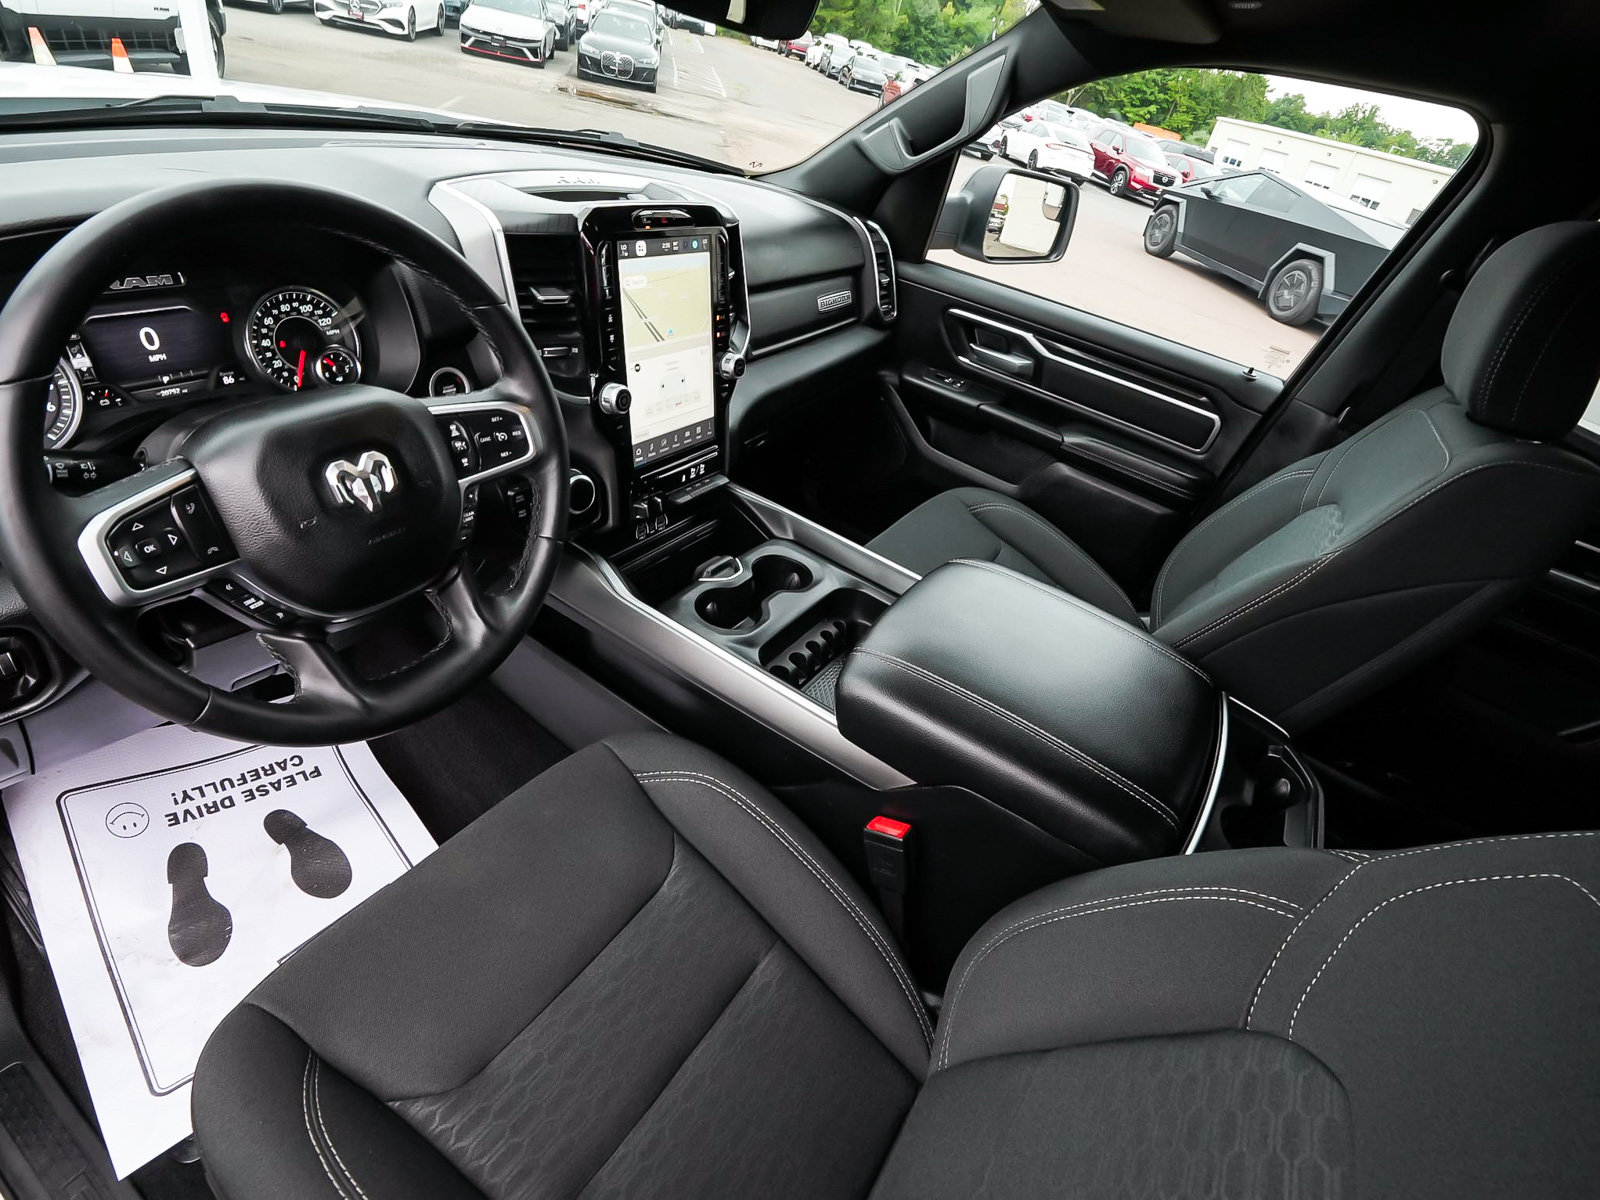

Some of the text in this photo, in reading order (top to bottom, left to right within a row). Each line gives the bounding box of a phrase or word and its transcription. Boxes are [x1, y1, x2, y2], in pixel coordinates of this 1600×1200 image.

[271, 308, 279, 316] 70
[280, 303, 291, 312] 80
[299, 303, 313, 313] 100
[263, 316, 274, 326] 60
[317, 317, 332, 326] 120
[138, 326, 161, 351] 0
[261, 339, 272, 347] 40
[148, 353, 167, 362] MPH
[272, 359, 283, 369] 20
[222, 375, 235, 385] 86
[143, 544, 157, 553] OK
[171, 754, 304, 806] CAREFULLY!
[164, 765, 323, 828] PLEASE DRIVE
